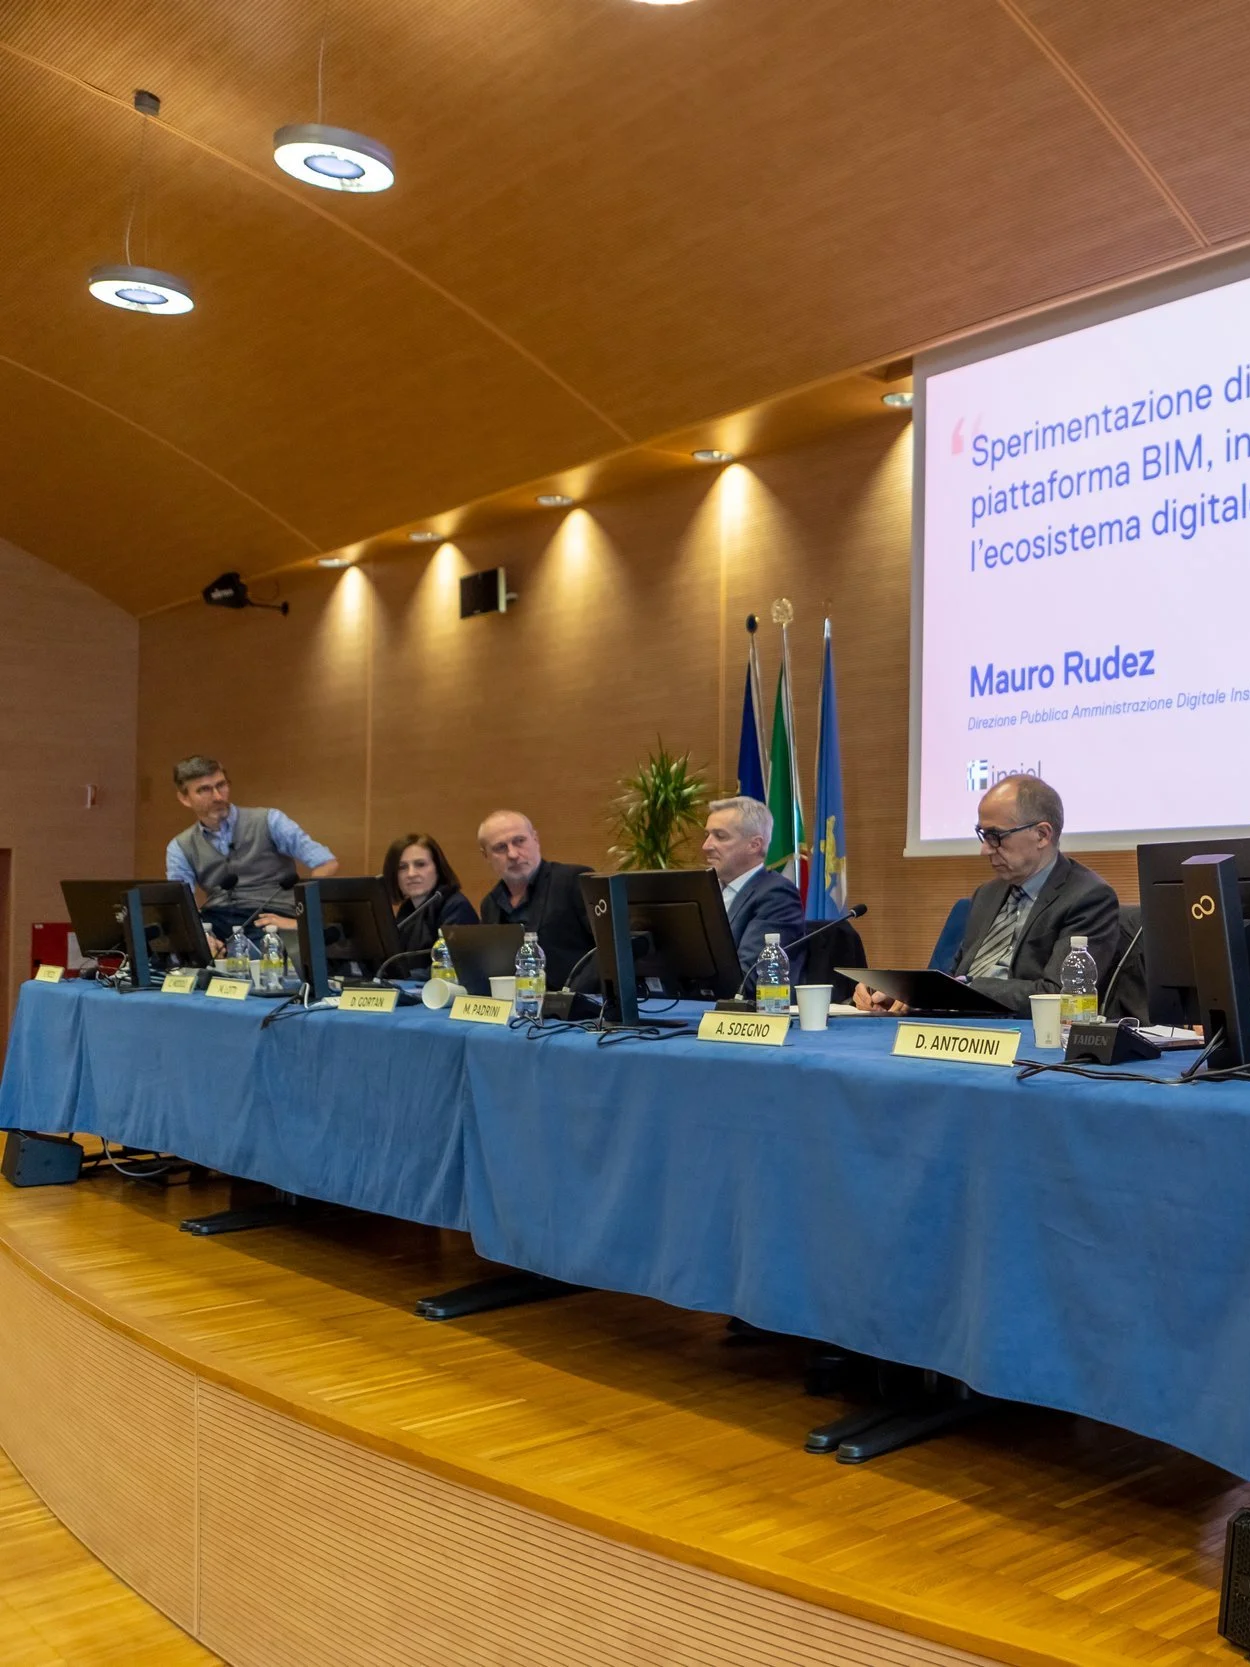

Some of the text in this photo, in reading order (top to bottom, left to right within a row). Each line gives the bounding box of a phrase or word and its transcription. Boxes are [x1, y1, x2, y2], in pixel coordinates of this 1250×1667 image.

[972, 384, 1212, 471] Sperimentazione
[1224, 364, 1250, 403] di
[971, 461, 1130, 528] piattaforma
[1142, 433, 1213, 480] BIM,
[971, 515, 1141, 572] l'ecosistema
[970, 645, 1155, 698] Mauro Rudez
[967, 714, 1017, 731] Direzione
[1019, 705, 1069, 726] Pubblica
[1071, 696, 1173, 720] Amministrazione
[1176, 689, 1226, 711] Digitale
[463, 1002, 501, 1018] M. PADRINI
[715, 1021, 770, 1038] A. SDEGNO
[915, 1033, 1000, 1056] D. ANTONINI
[1073, 1034, 1108, 1046] TAIDEN
